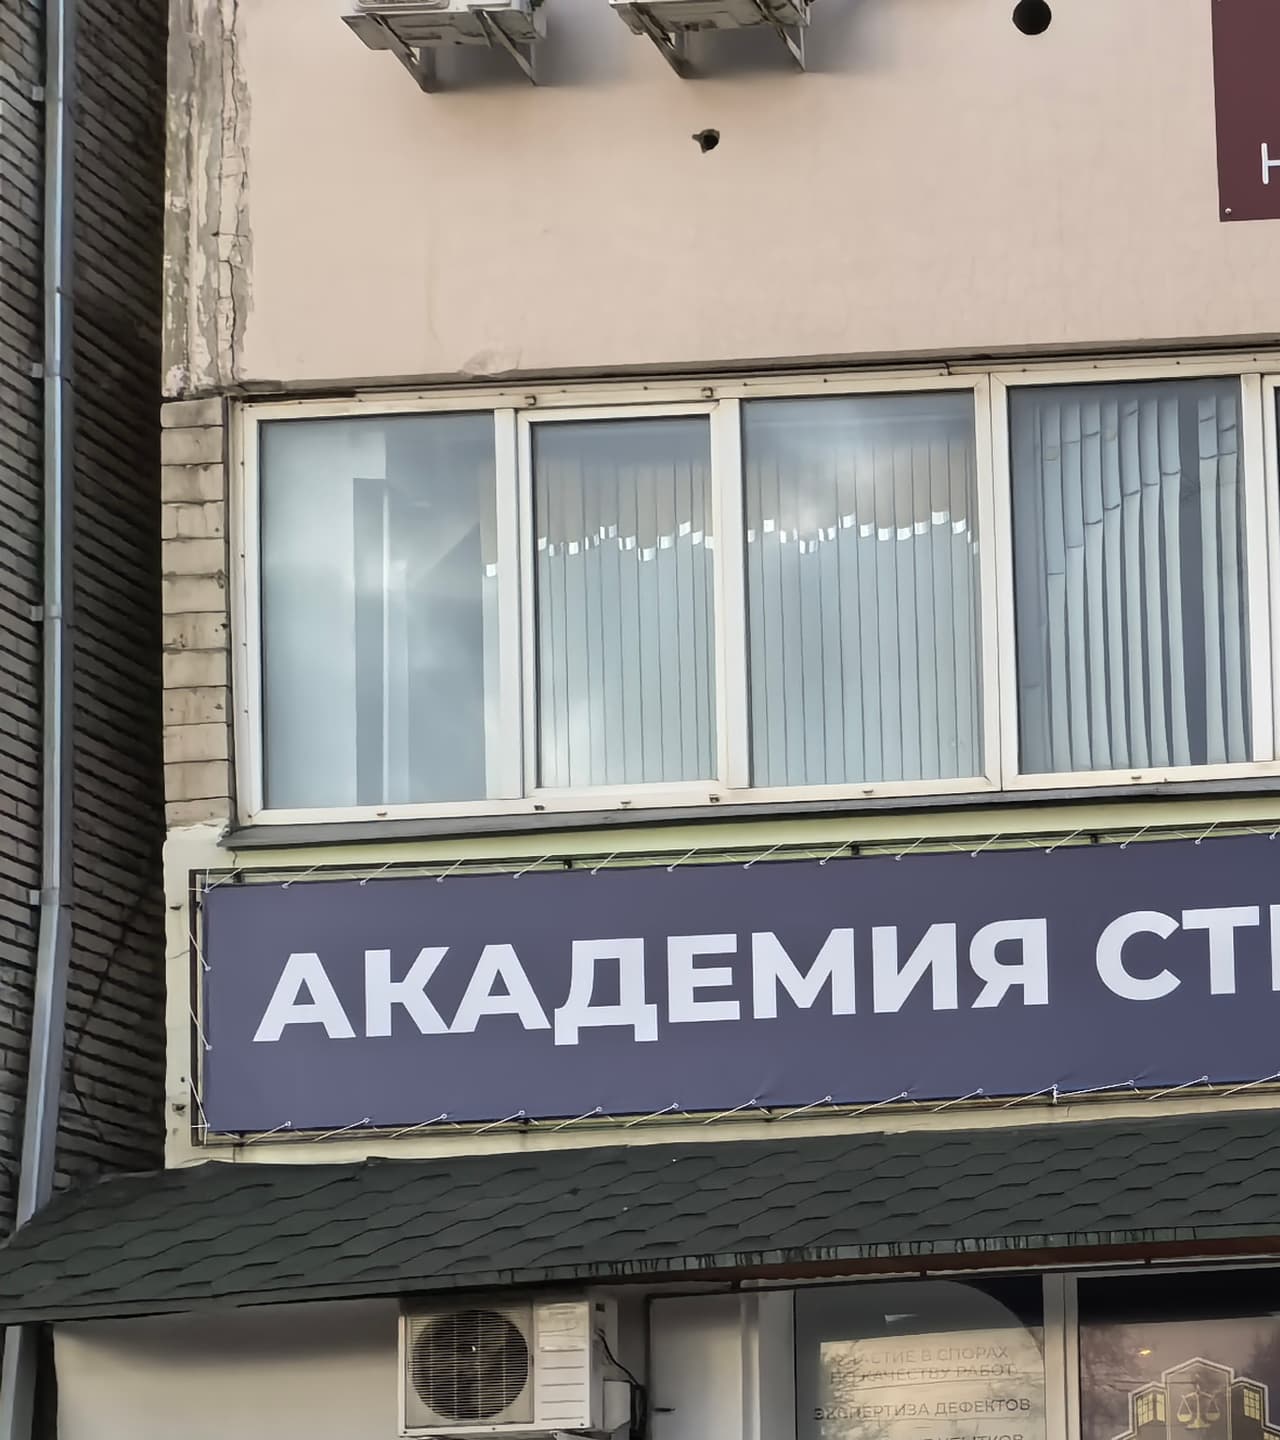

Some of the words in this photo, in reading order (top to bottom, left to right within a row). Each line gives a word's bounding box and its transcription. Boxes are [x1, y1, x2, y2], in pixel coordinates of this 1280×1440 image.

[253, 918, 1049, 1046] АКАДЕМИЯ
[938, 1346, 1008, 1361] СПОРАХ
[957, 1364, 1015, 1378] РАБОТ
[935, 1399, 1030, 1416] ДЕФЕКТОВ
